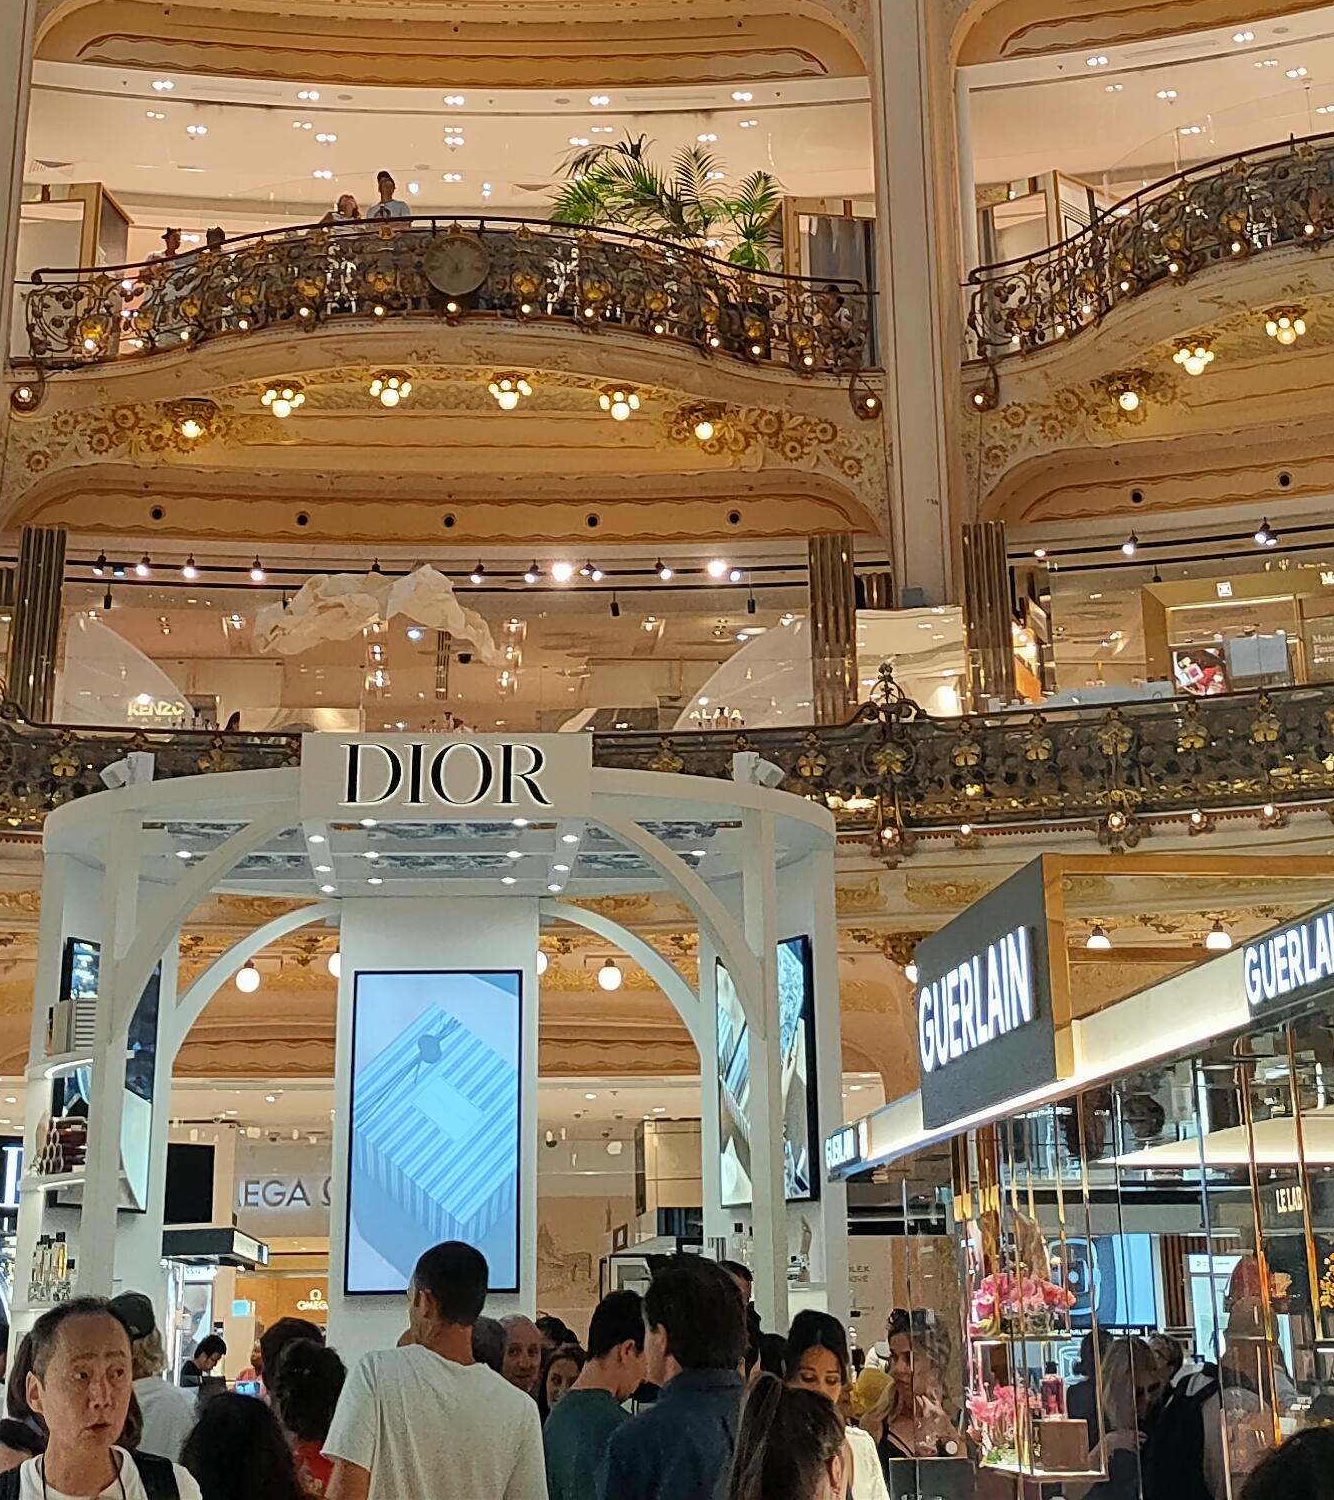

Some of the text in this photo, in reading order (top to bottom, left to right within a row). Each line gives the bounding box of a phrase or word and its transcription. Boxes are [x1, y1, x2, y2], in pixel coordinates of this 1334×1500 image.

[127, 700, 185, 716] KENZO
[341, 742, 552, 806] DIOR
[918, 925, 1034, 1074] GUERLAIN
[239, 1179, 311, 1207] EGA
[1276, 1186, 1303, 1213] LE LAB
